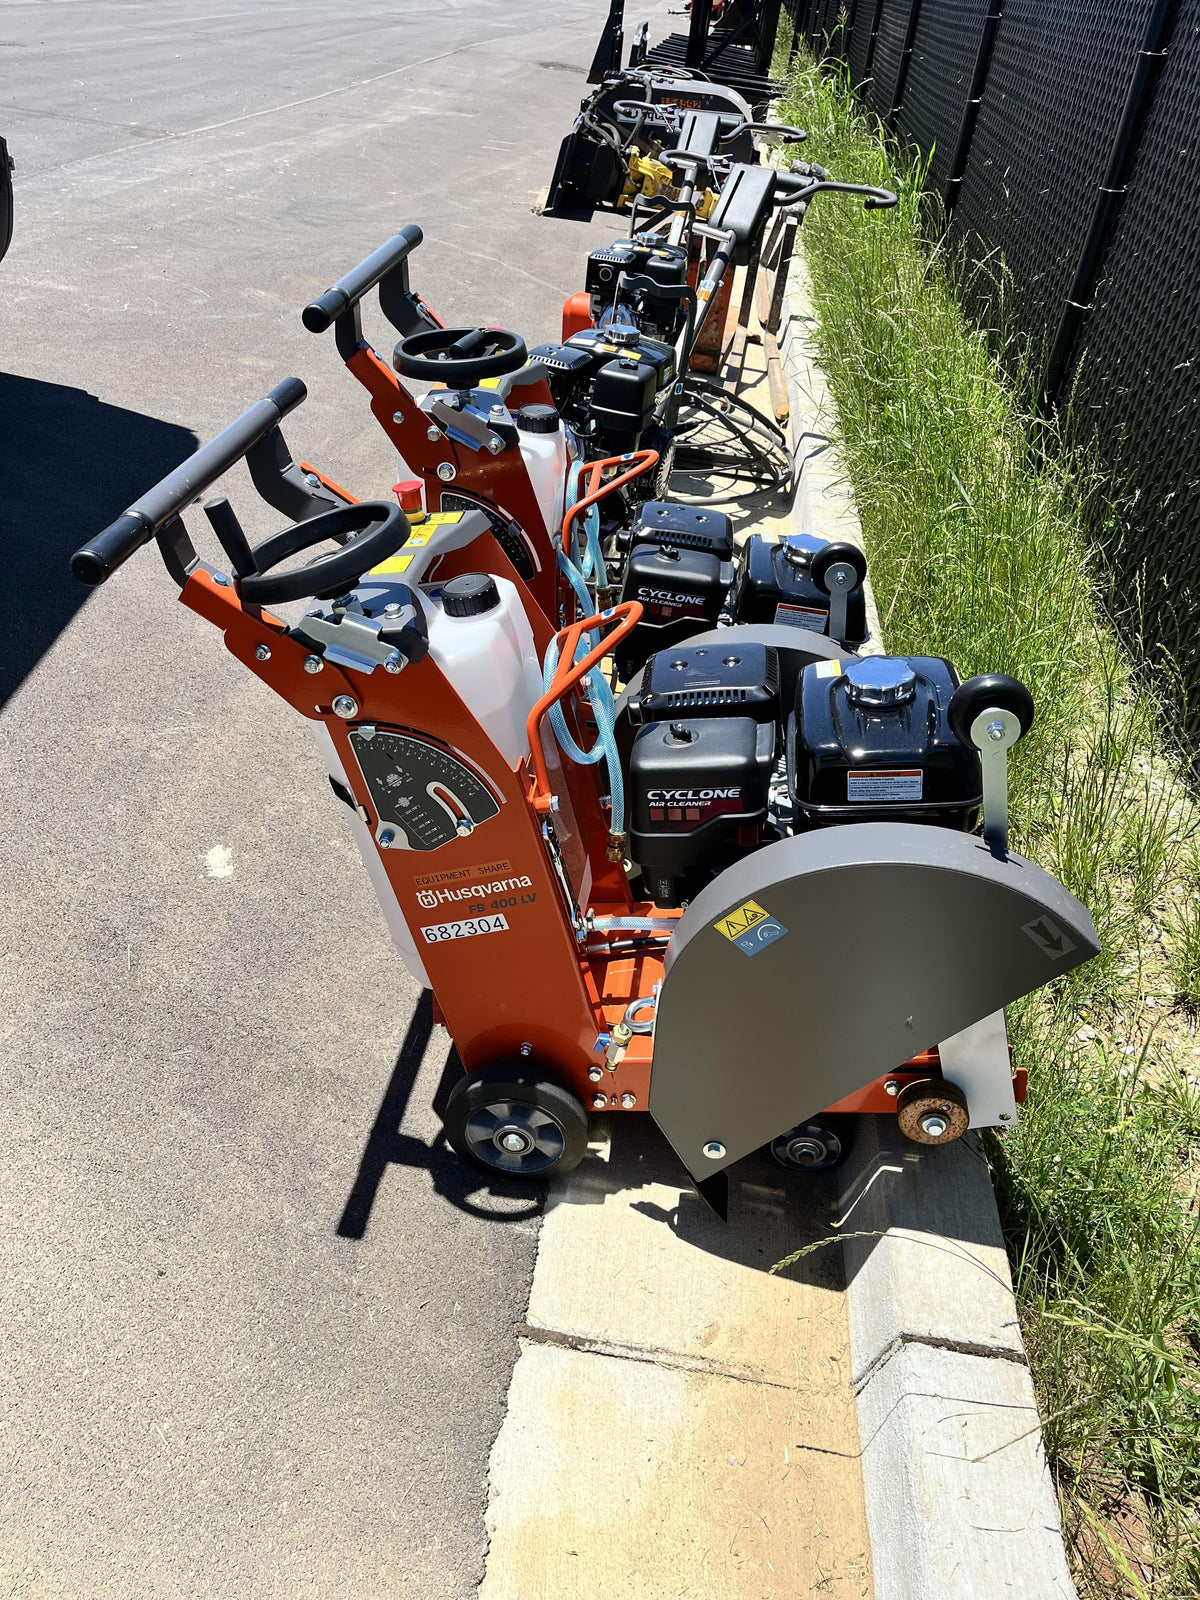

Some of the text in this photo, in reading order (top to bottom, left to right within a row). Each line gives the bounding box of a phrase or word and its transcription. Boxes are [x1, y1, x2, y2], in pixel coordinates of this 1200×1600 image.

[637, 587, 706, 605] CYCLONE
[647, 788, 741, 800] CYCLONE
[415, 862, 511, 886] EQUIPMENT SHARE
[435, 875, 533, 904] Husqvarna
[468, 892, 537, 914] FS 400 LV
[424, 916, 505, 942] 682304
